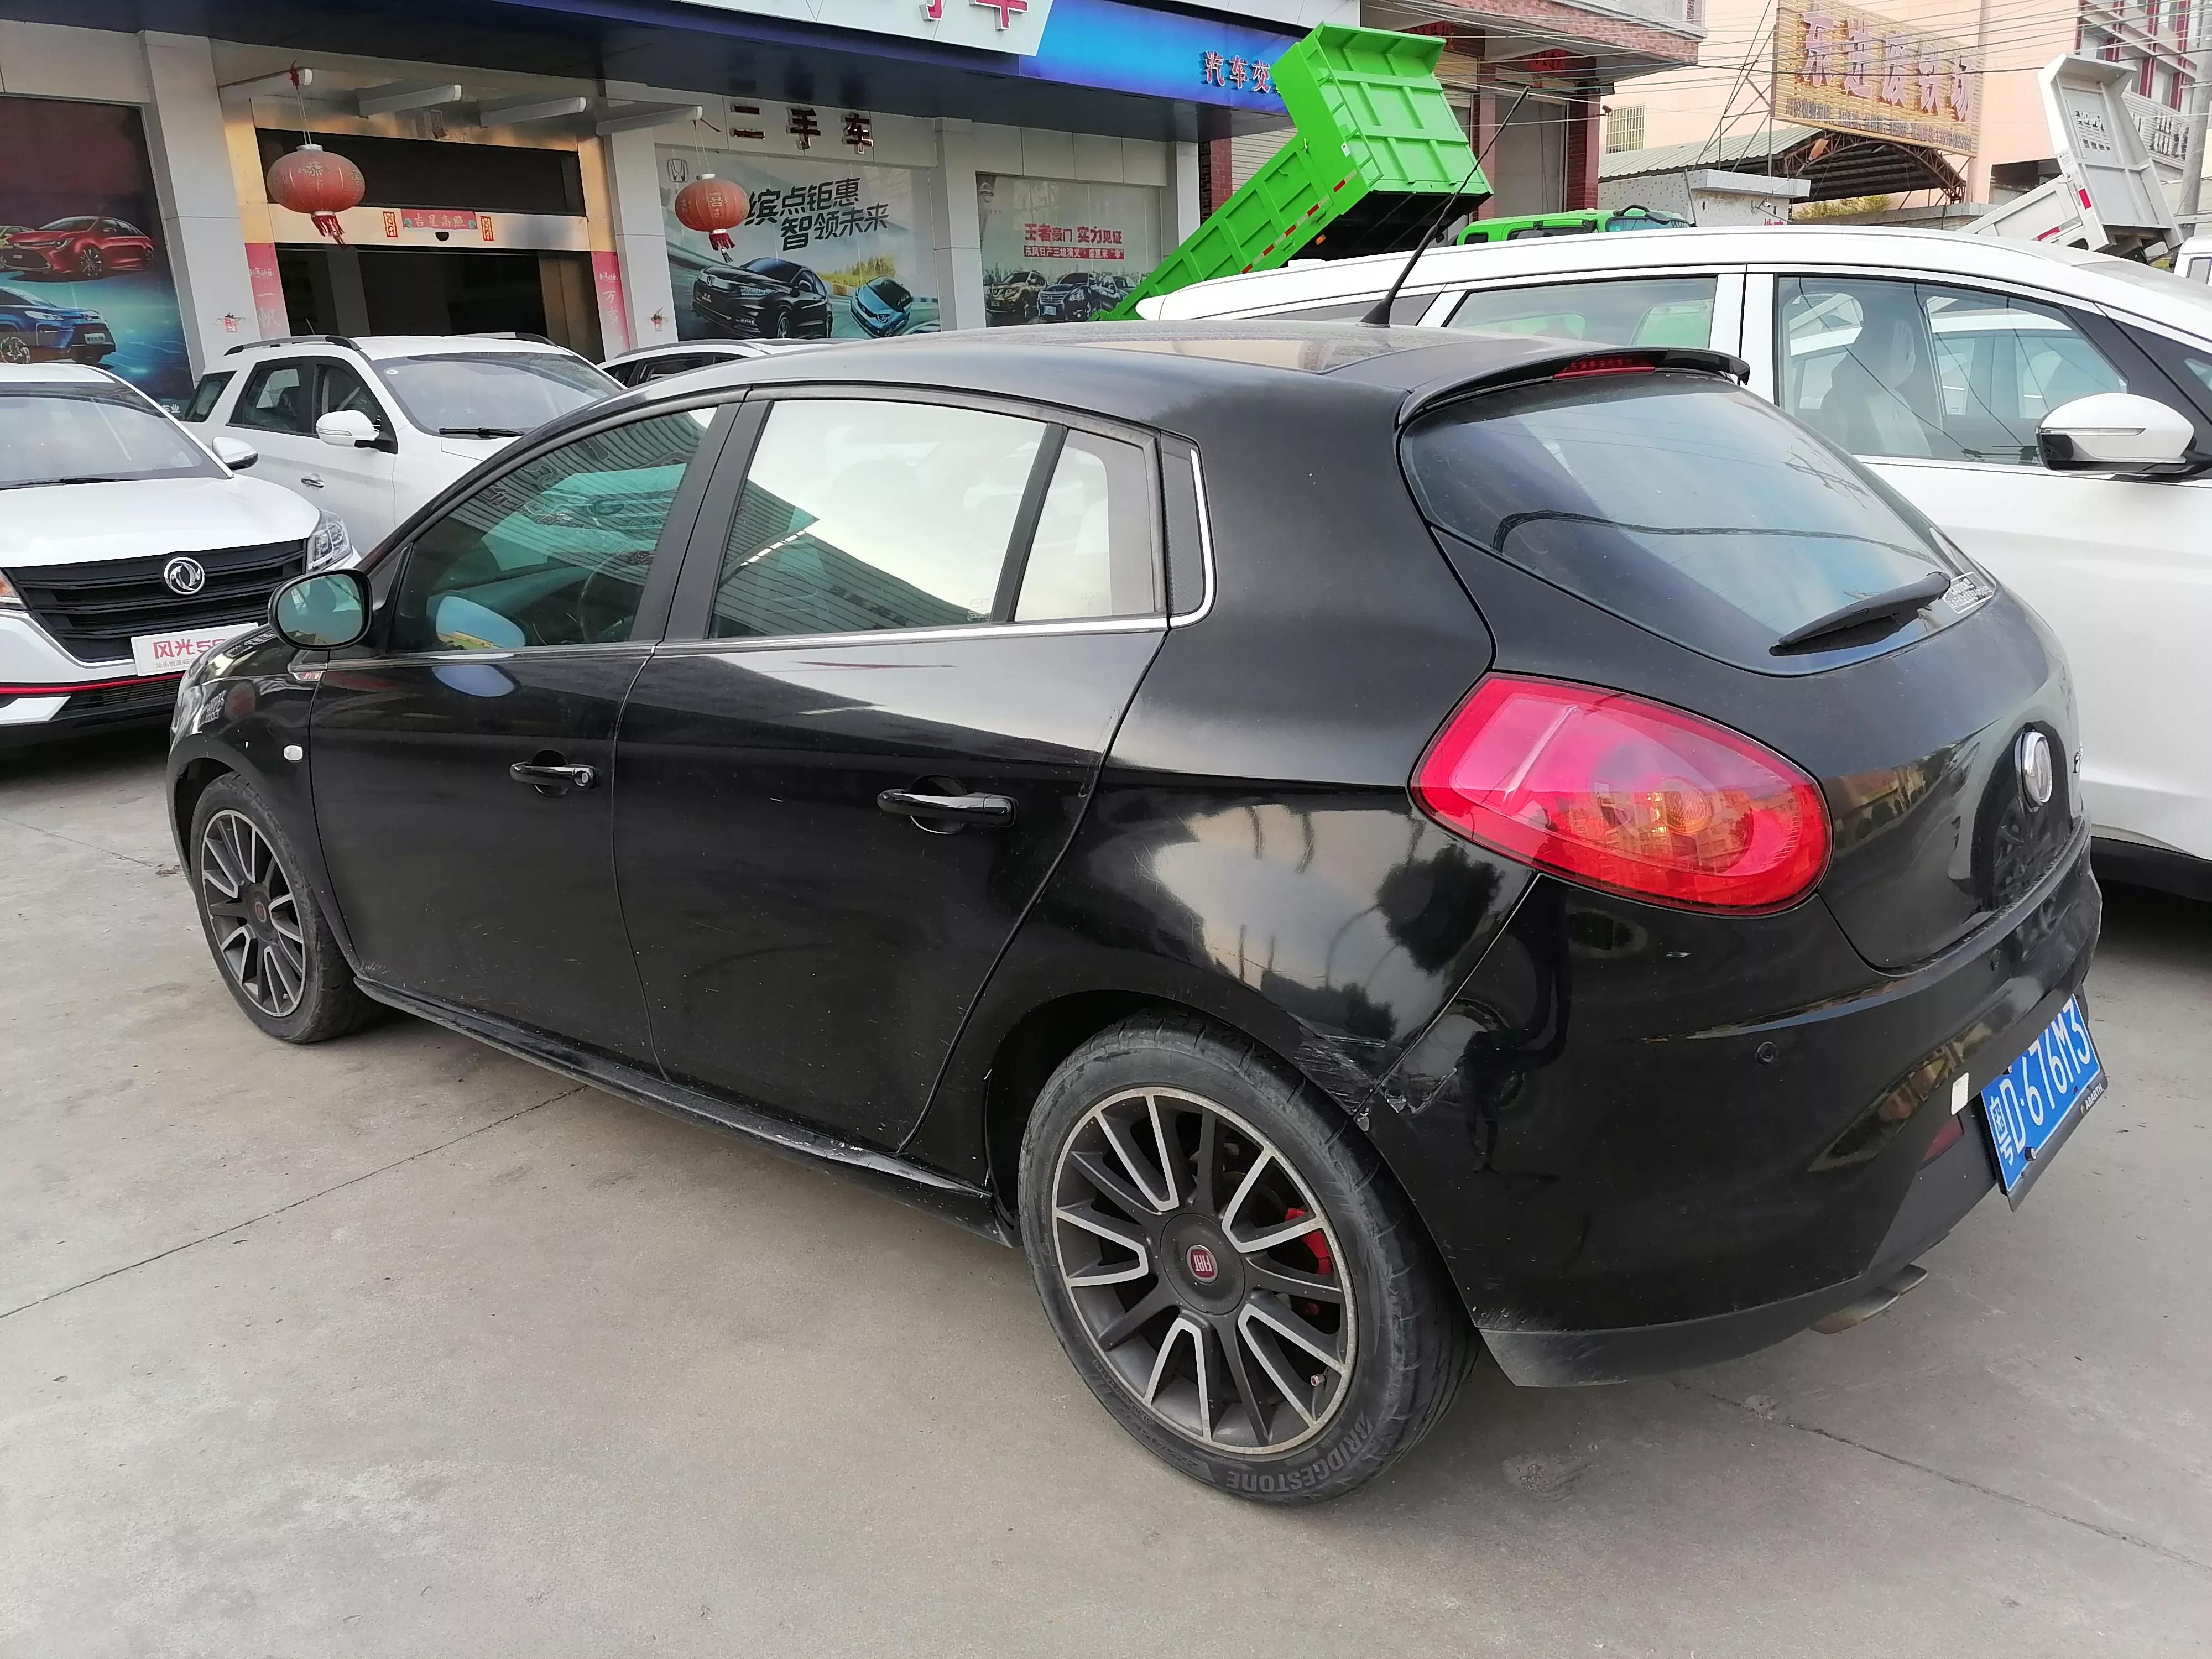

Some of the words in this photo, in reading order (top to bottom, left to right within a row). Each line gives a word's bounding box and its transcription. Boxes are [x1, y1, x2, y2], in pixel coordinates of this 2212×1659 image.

[1204, 50, 1273, 93] 汽车交
[730, 105, 873, 154] 二手车
[780, 202, 889, 252] 智领未来
[1024, 223, 1073, 242] 王者豪门
[1077, 226, 1123, 244] 实力见证
[2085, 1083, 2103, 1110] ABARTH
[1193, 1254, 1213, 1272] FIAT
[1225, 1410, 1373, 1492] BRIDGESTONE
